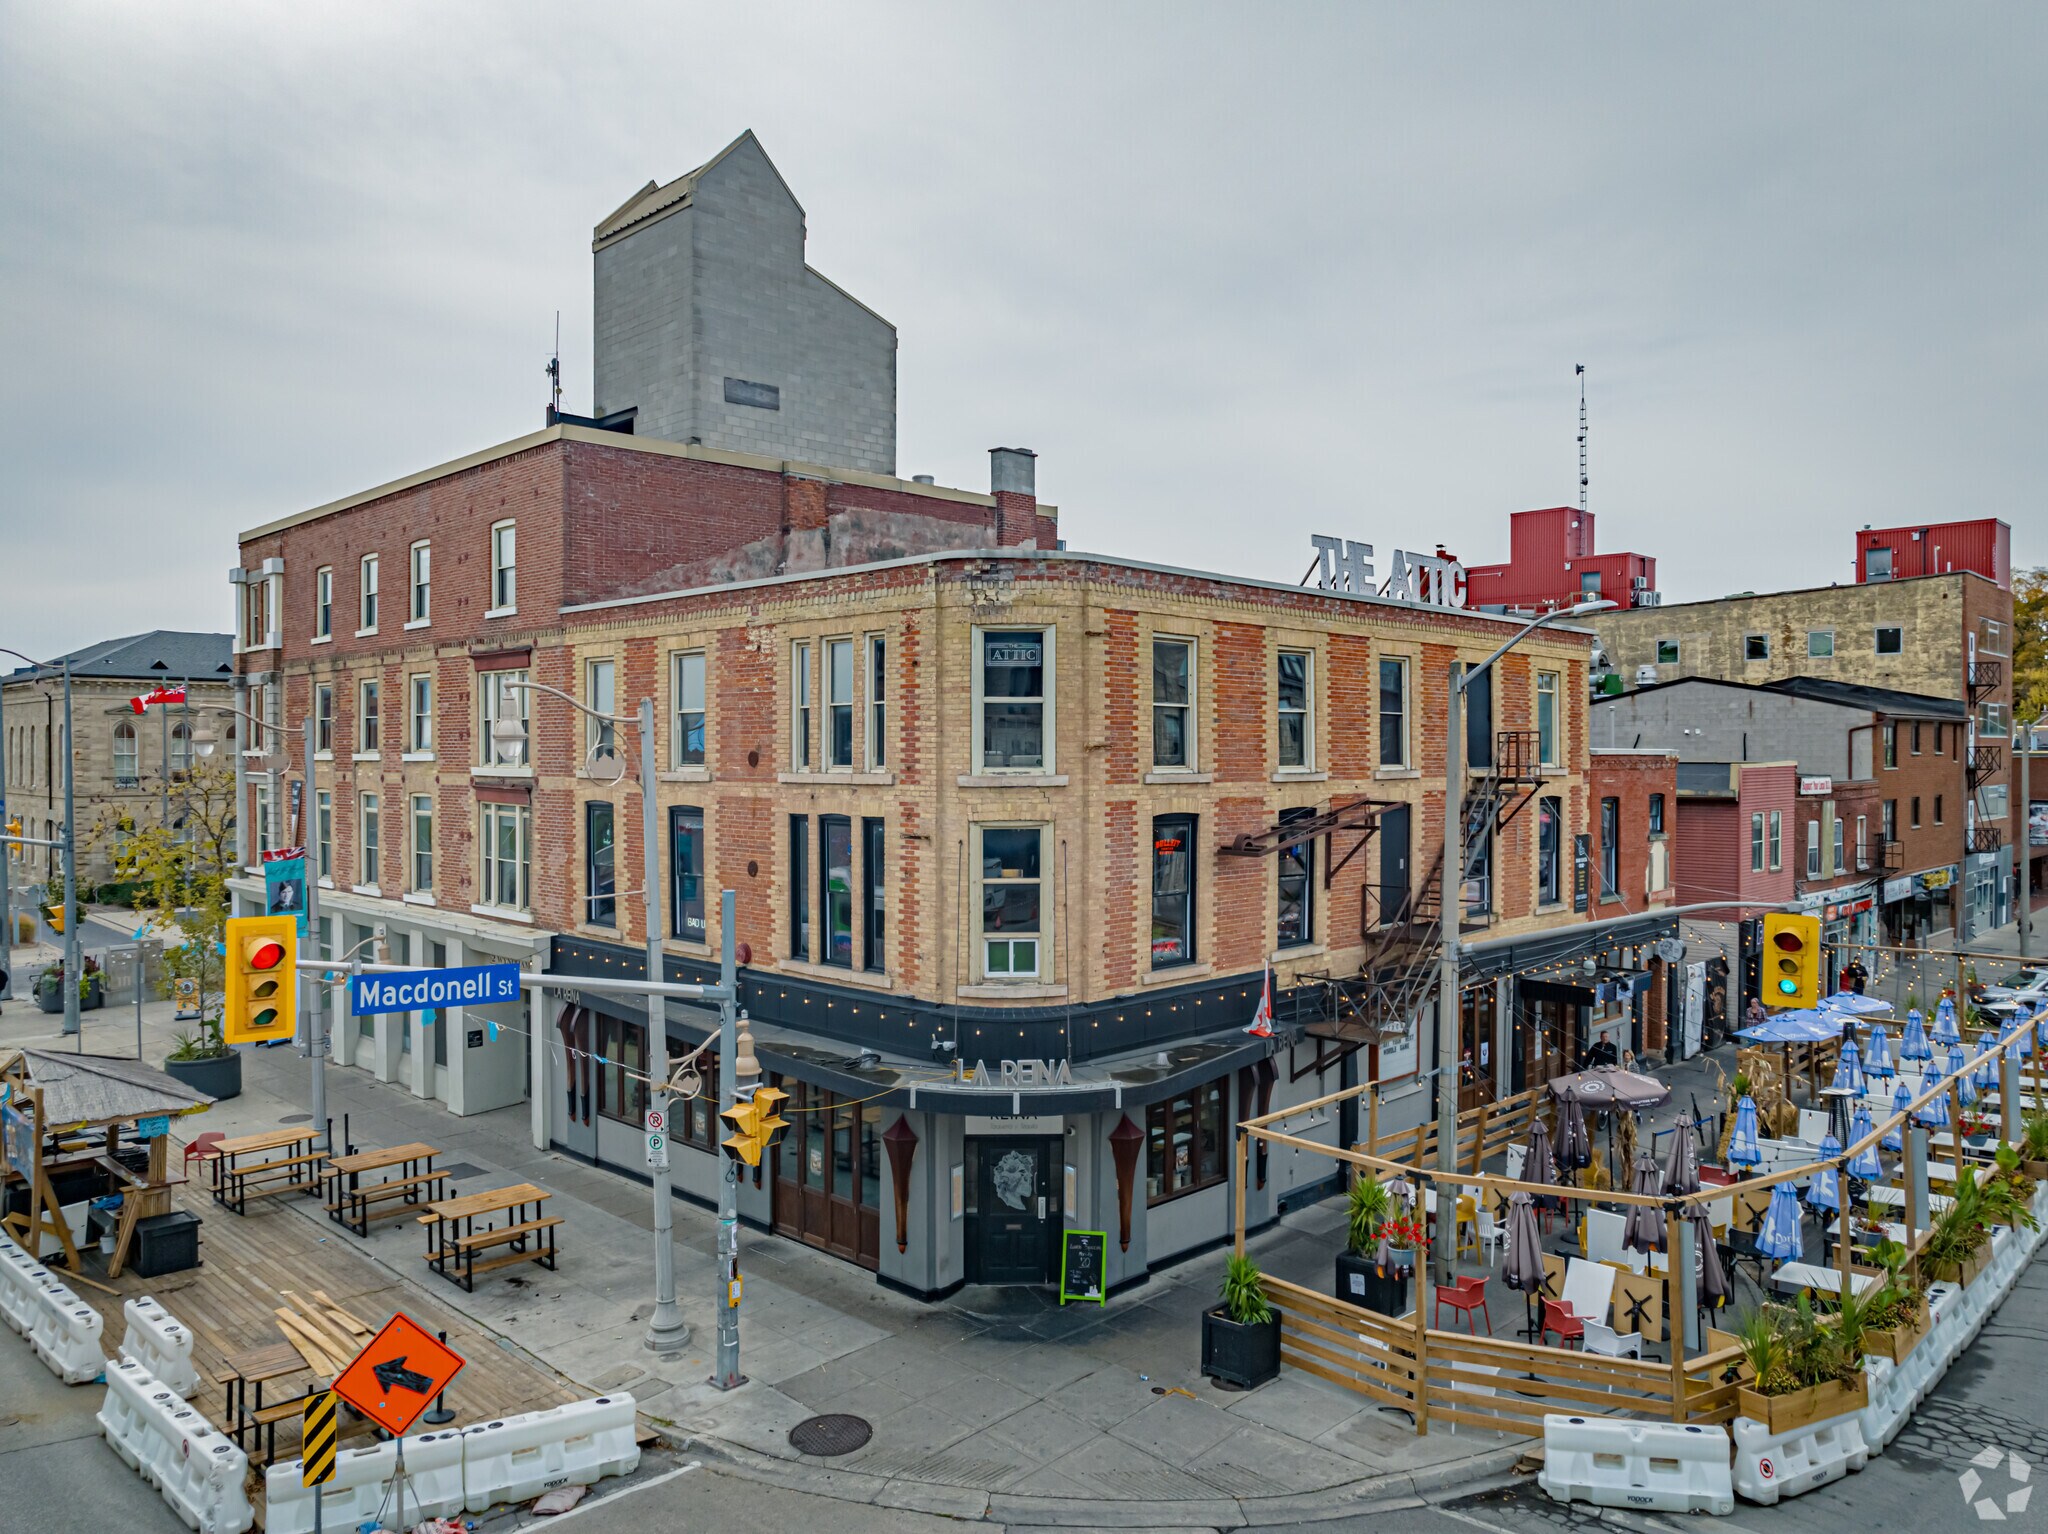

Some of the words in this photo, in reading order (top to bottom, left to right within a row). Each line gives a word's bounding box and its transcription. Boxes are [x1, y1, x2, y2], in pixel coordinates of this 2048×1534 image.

[1311, 534, 1376, 597] THE
[1390, 549, 1467, 608] ATTIC
[992, 650, 1036, 660] ATTIC
[360, 972, 491, 1008] Macdonell
[498, 980, 514, 996] St
[957, 1058, 991, 1086] LA
[1000, 1058, 1073, 1087] REINA
[543, 1477, 569, 1488] YODOCK
[1627, 1495, 1654, 1504] YODOCK
